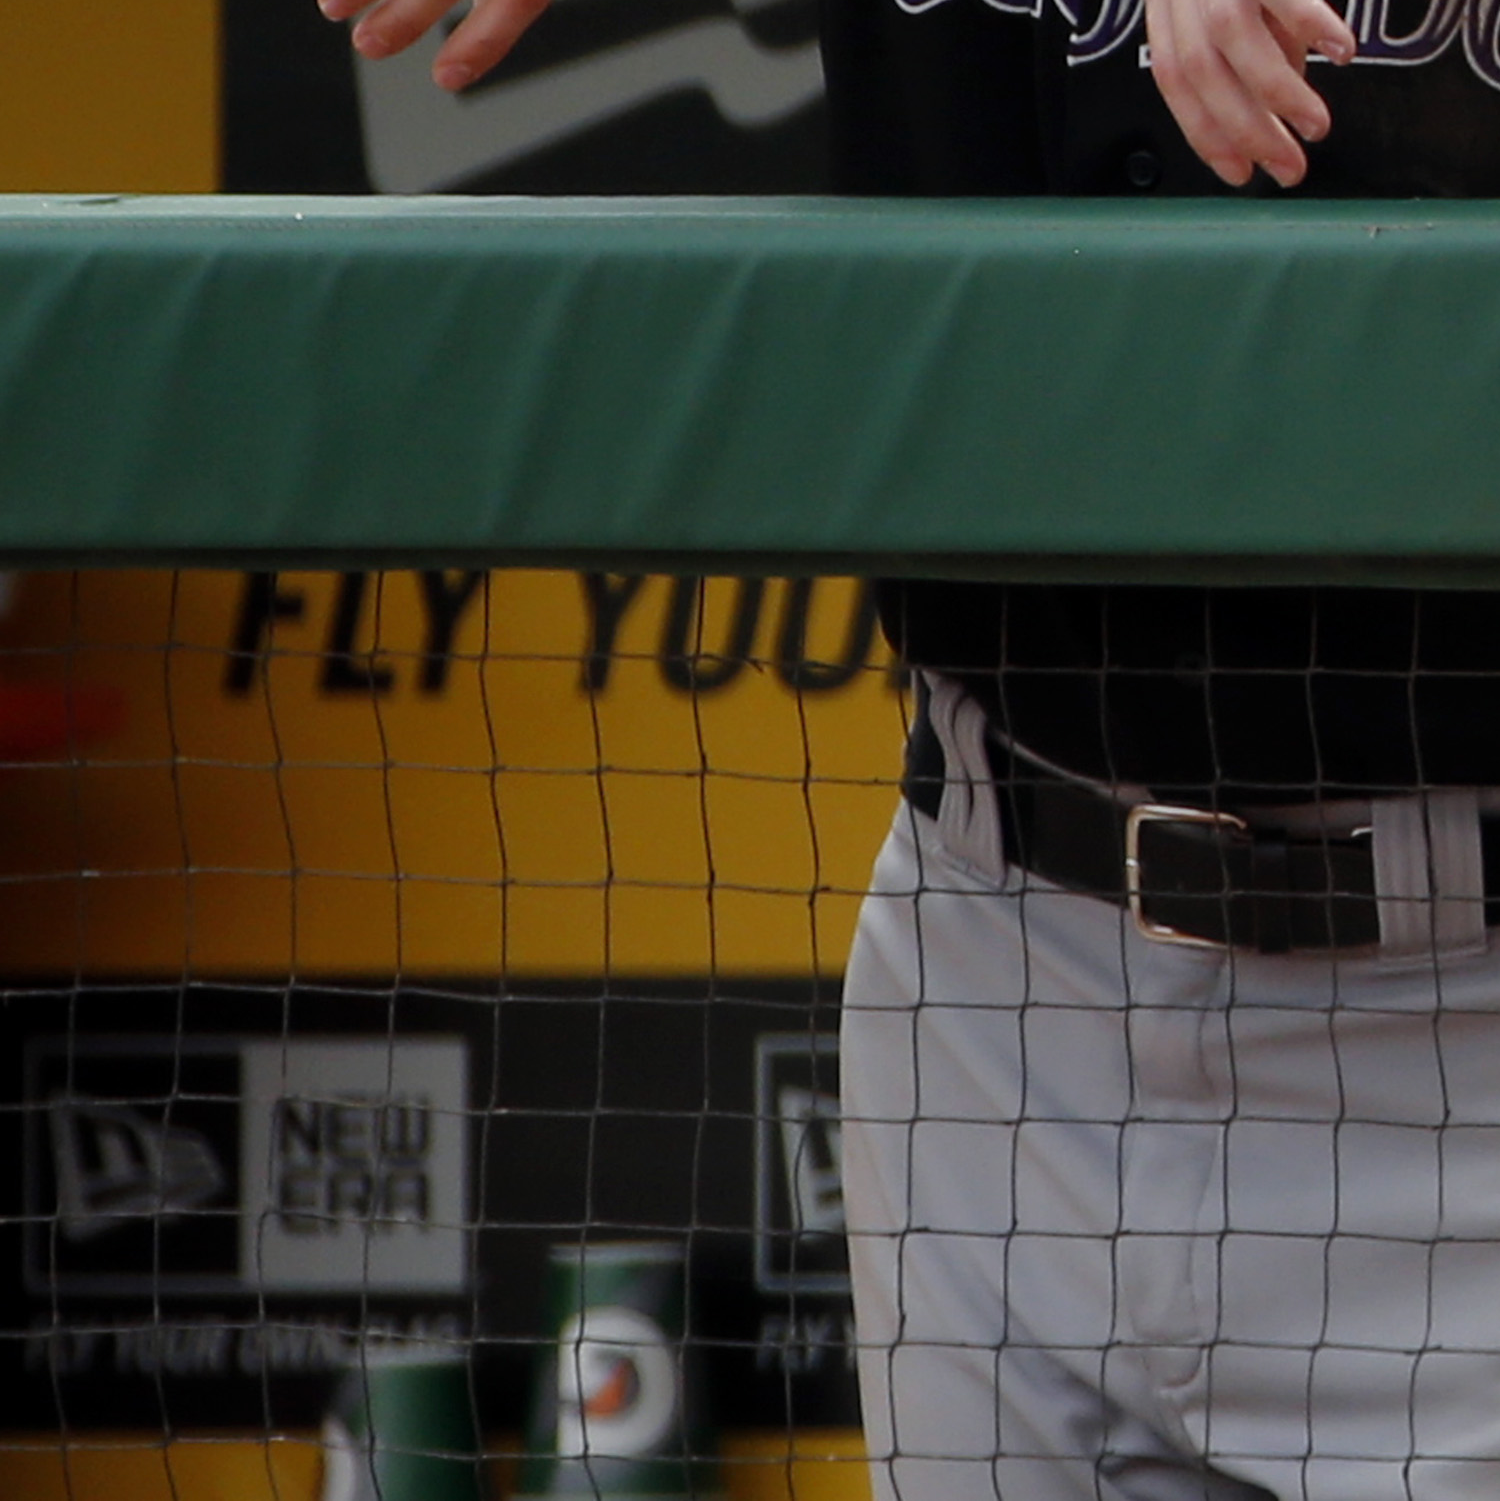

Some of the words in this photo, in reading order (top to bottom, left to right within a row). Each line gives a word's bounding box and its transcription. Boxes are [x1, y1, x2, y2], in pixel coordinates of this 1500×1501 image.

[578, 573, 908, 696] YOU
[279, 1093, 430, 1159] NEW
[279, 1166, 430, 1236] ERA
